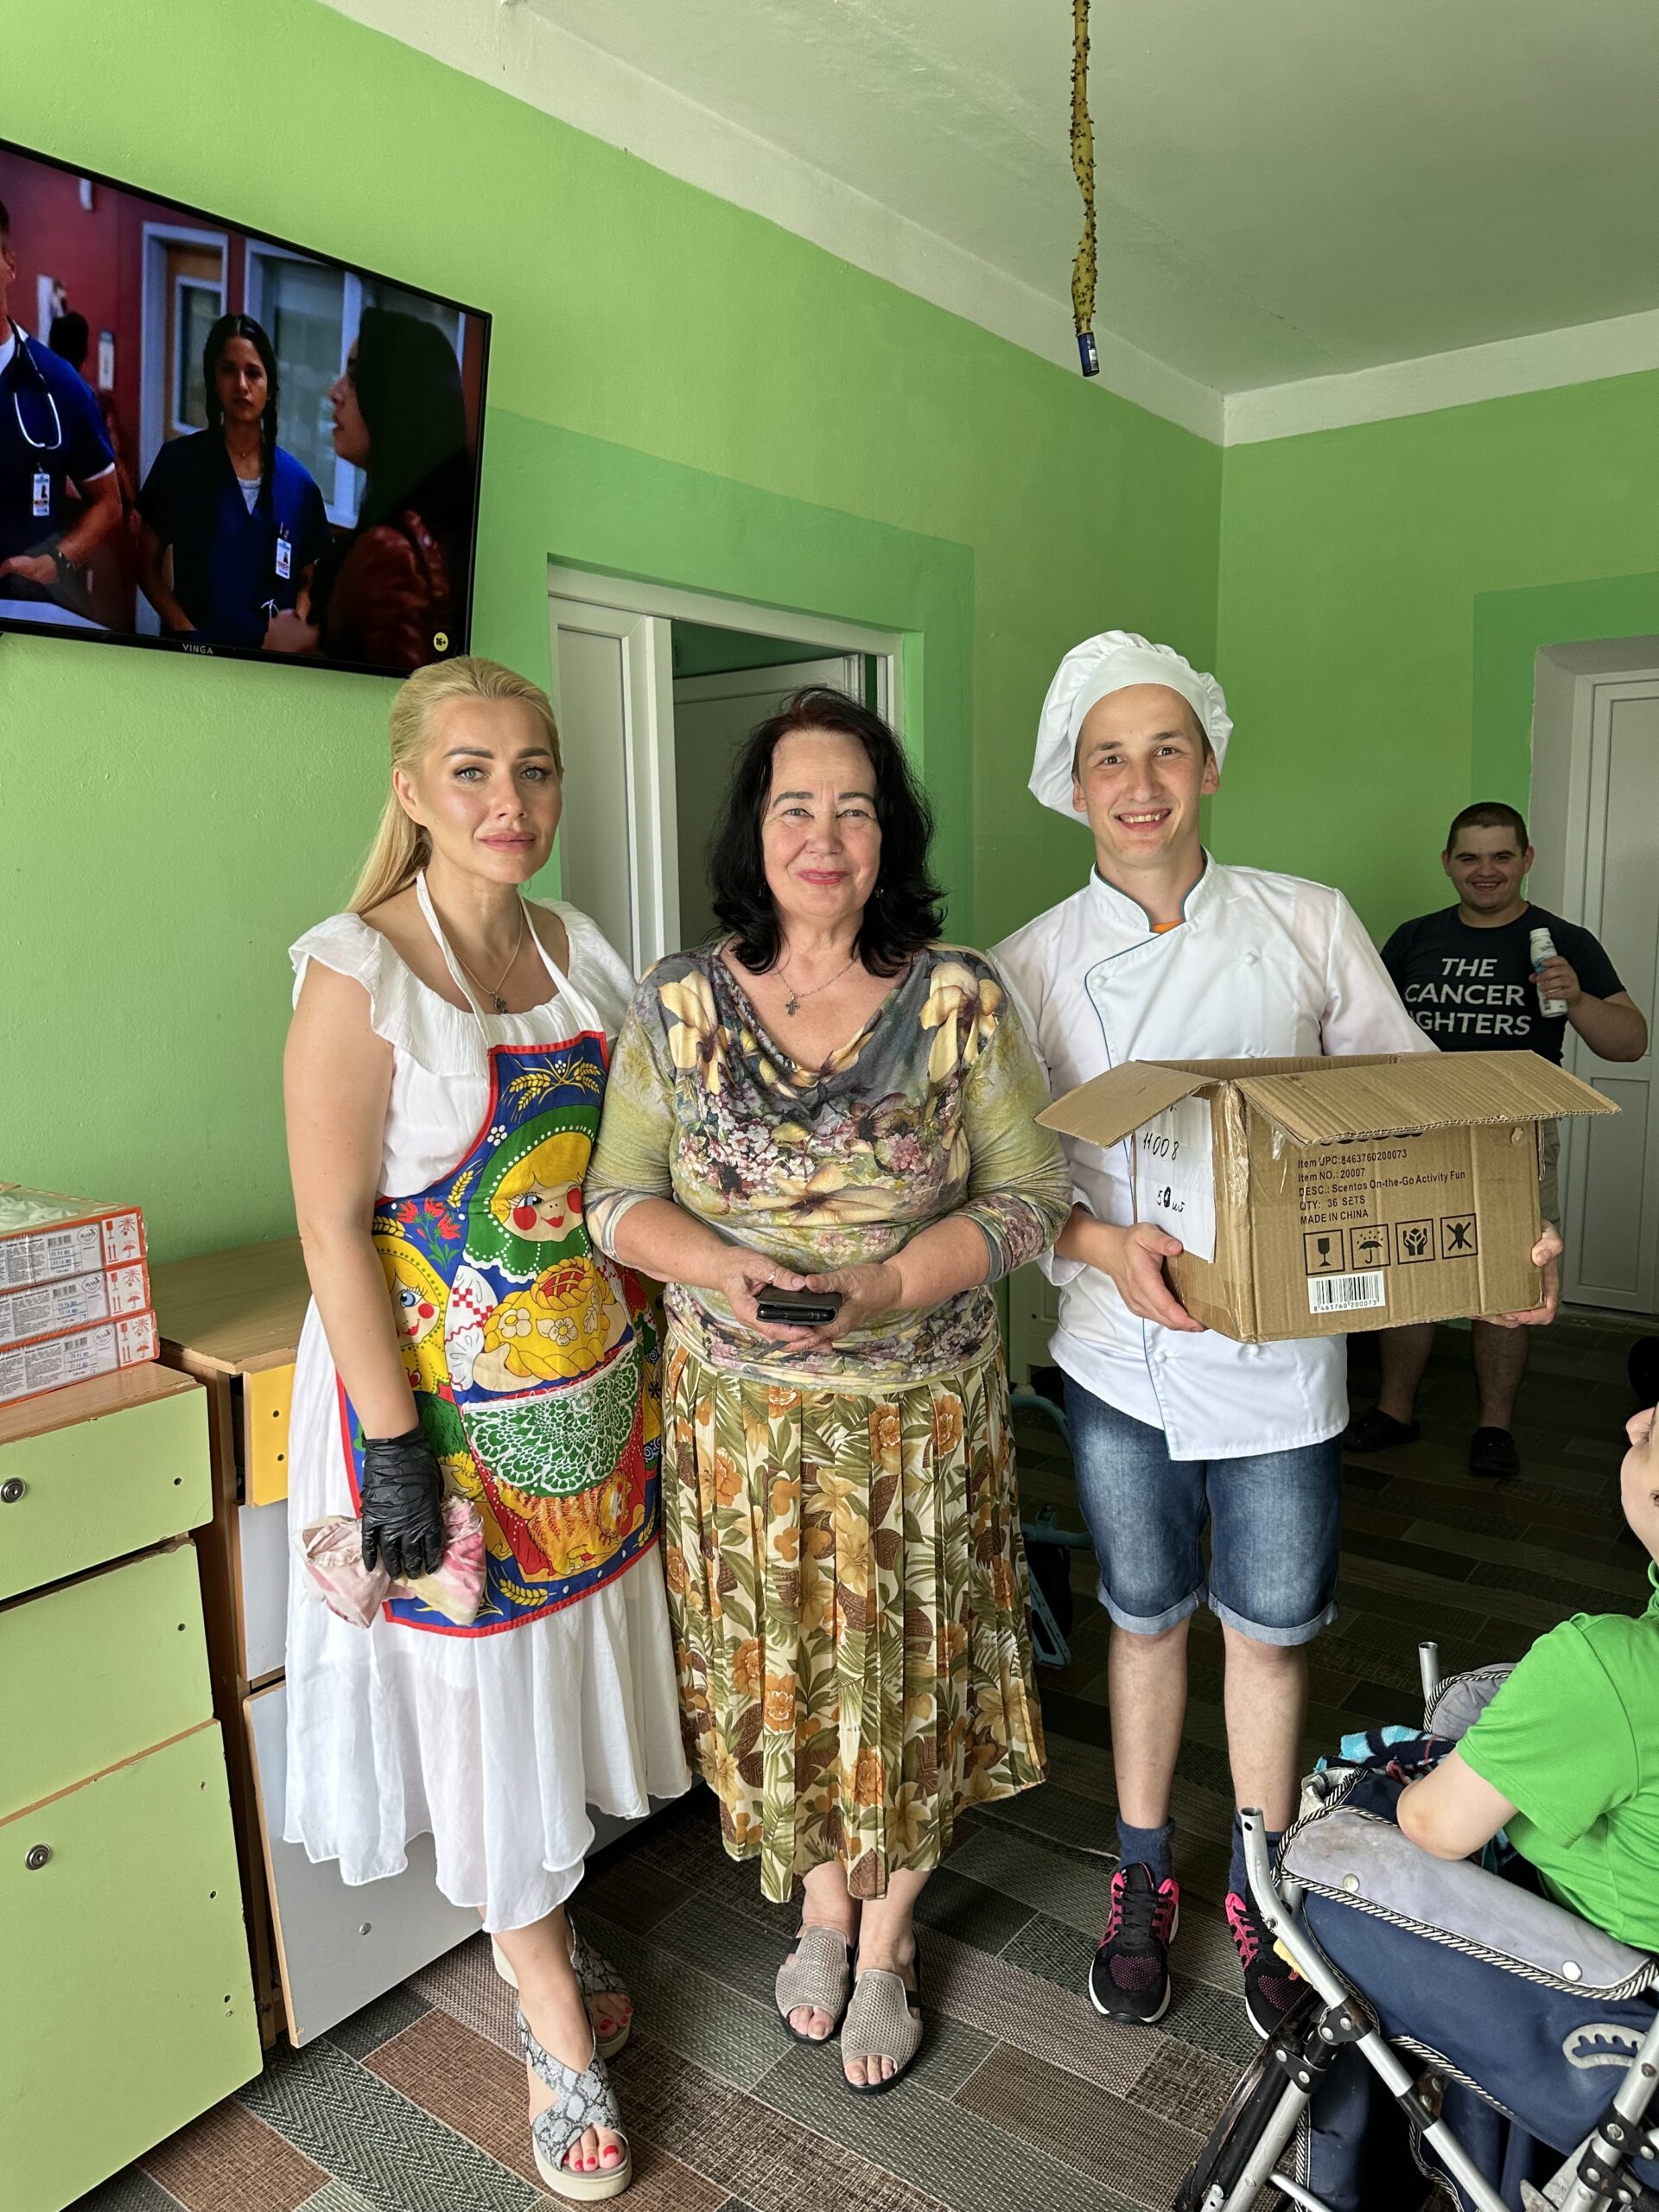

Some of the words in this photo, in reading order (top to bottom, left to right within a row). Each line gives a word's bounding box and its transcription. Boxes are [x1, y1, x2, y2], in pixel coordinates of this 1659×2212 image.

[182, 643, 213, 655] VINGA
[1441, 957, 1498, 977] THE
[1404, 982, 1526, 1007] CANCER
[1409, 1010, 1532, 1035] GHTERS
[1298, 1159, 1317, 1168] Item
[1299, 1173, 1318, 1183] Item
[1340, 1168, 1366, 1179] 20007
[1332, 1181, 1368, 1193] Scentos
[1370, 1176, 1414, 1189] On-the-Go
[1415, 1171, 1449, 1185] Activity
[1450, 1170, 1465, 1180] Fun
[1300, 1200, 1321, 1211] QTY:
[1327, 1198, 1338, 1207] 36
[1342, 1195, 1365, 1206] SETS
[1300, 1213, 1327, 1225] MADE
[1328, 1211, 1338, 1222] IN
[1340, 1209, 1369, 1220] CHINA
